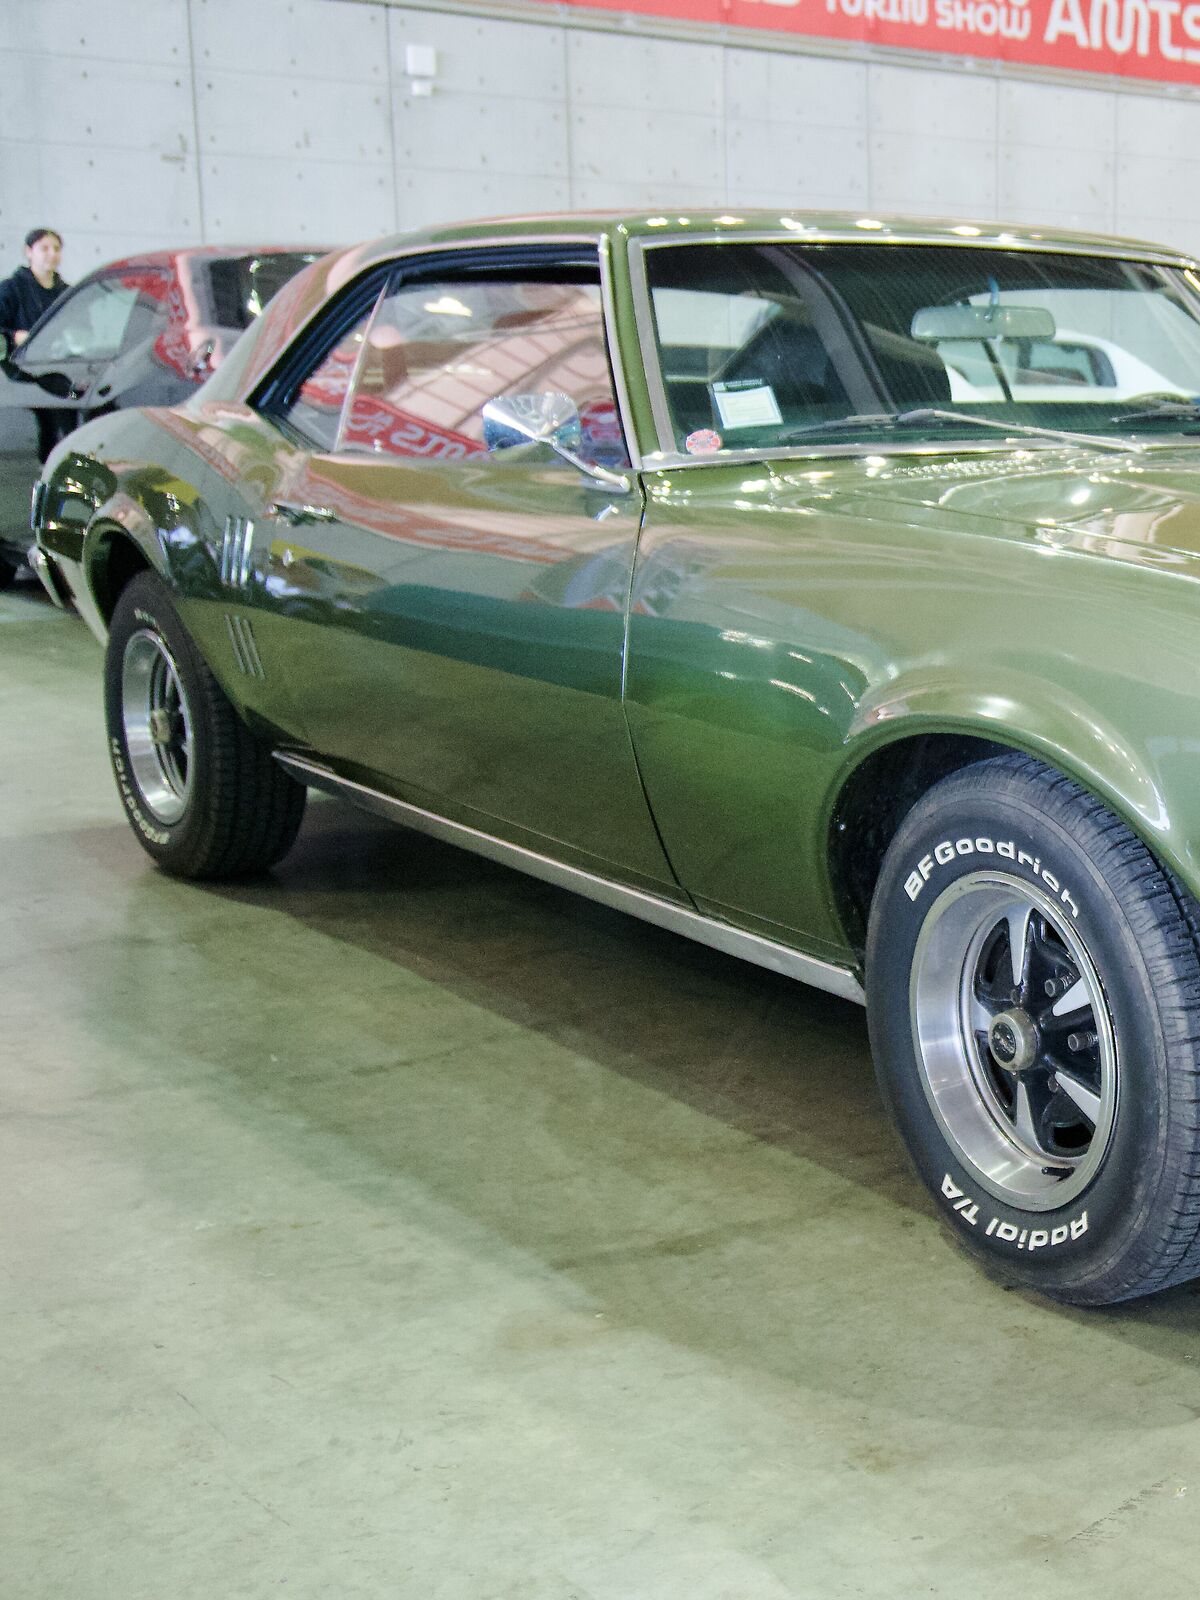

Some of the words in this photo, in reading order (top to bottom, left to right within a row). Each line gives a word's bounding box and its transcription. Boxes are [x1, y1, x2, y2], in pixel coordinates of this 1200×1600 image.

[935, 0, 1032, 39] SHOW
[903, 837, 1080, 919] BFGoodrich
[941, 1173, 980, 1226] T/A
[985, 1211, 1088, 1251] Radial
